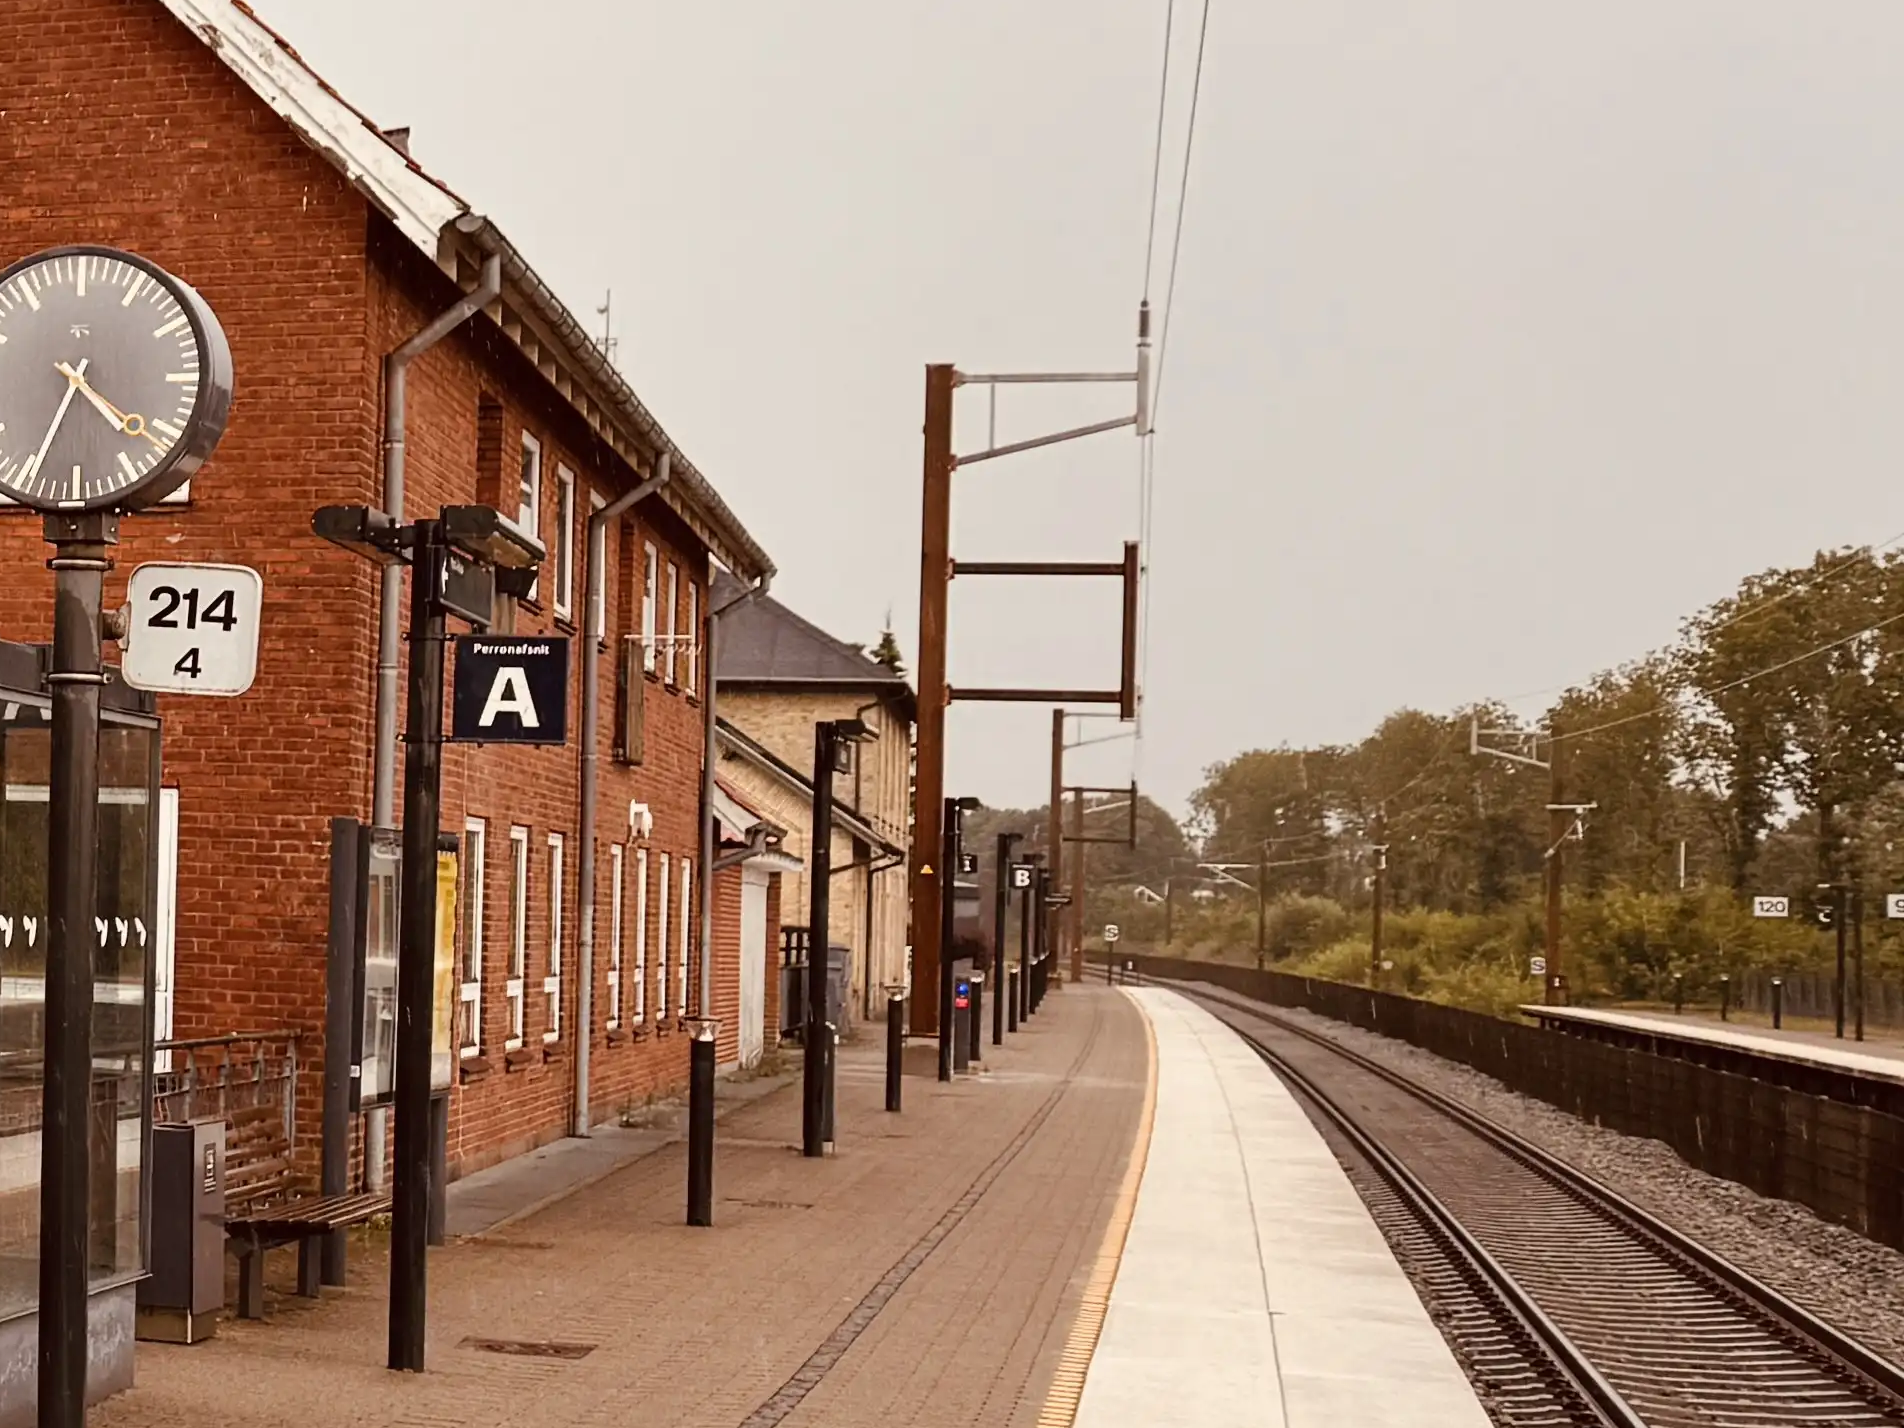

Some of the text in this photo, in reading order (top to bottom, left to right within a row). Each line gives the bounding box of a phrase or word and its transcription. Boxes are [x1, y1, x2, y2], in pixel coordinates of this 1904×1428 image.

[148, 586, 237, 631] 214
[174, 648, 201, 678] 4
[479, 667, 539, 727] A
[1015, 870, 1030, 886] B
[1759, 901, 1785, 912] 120
